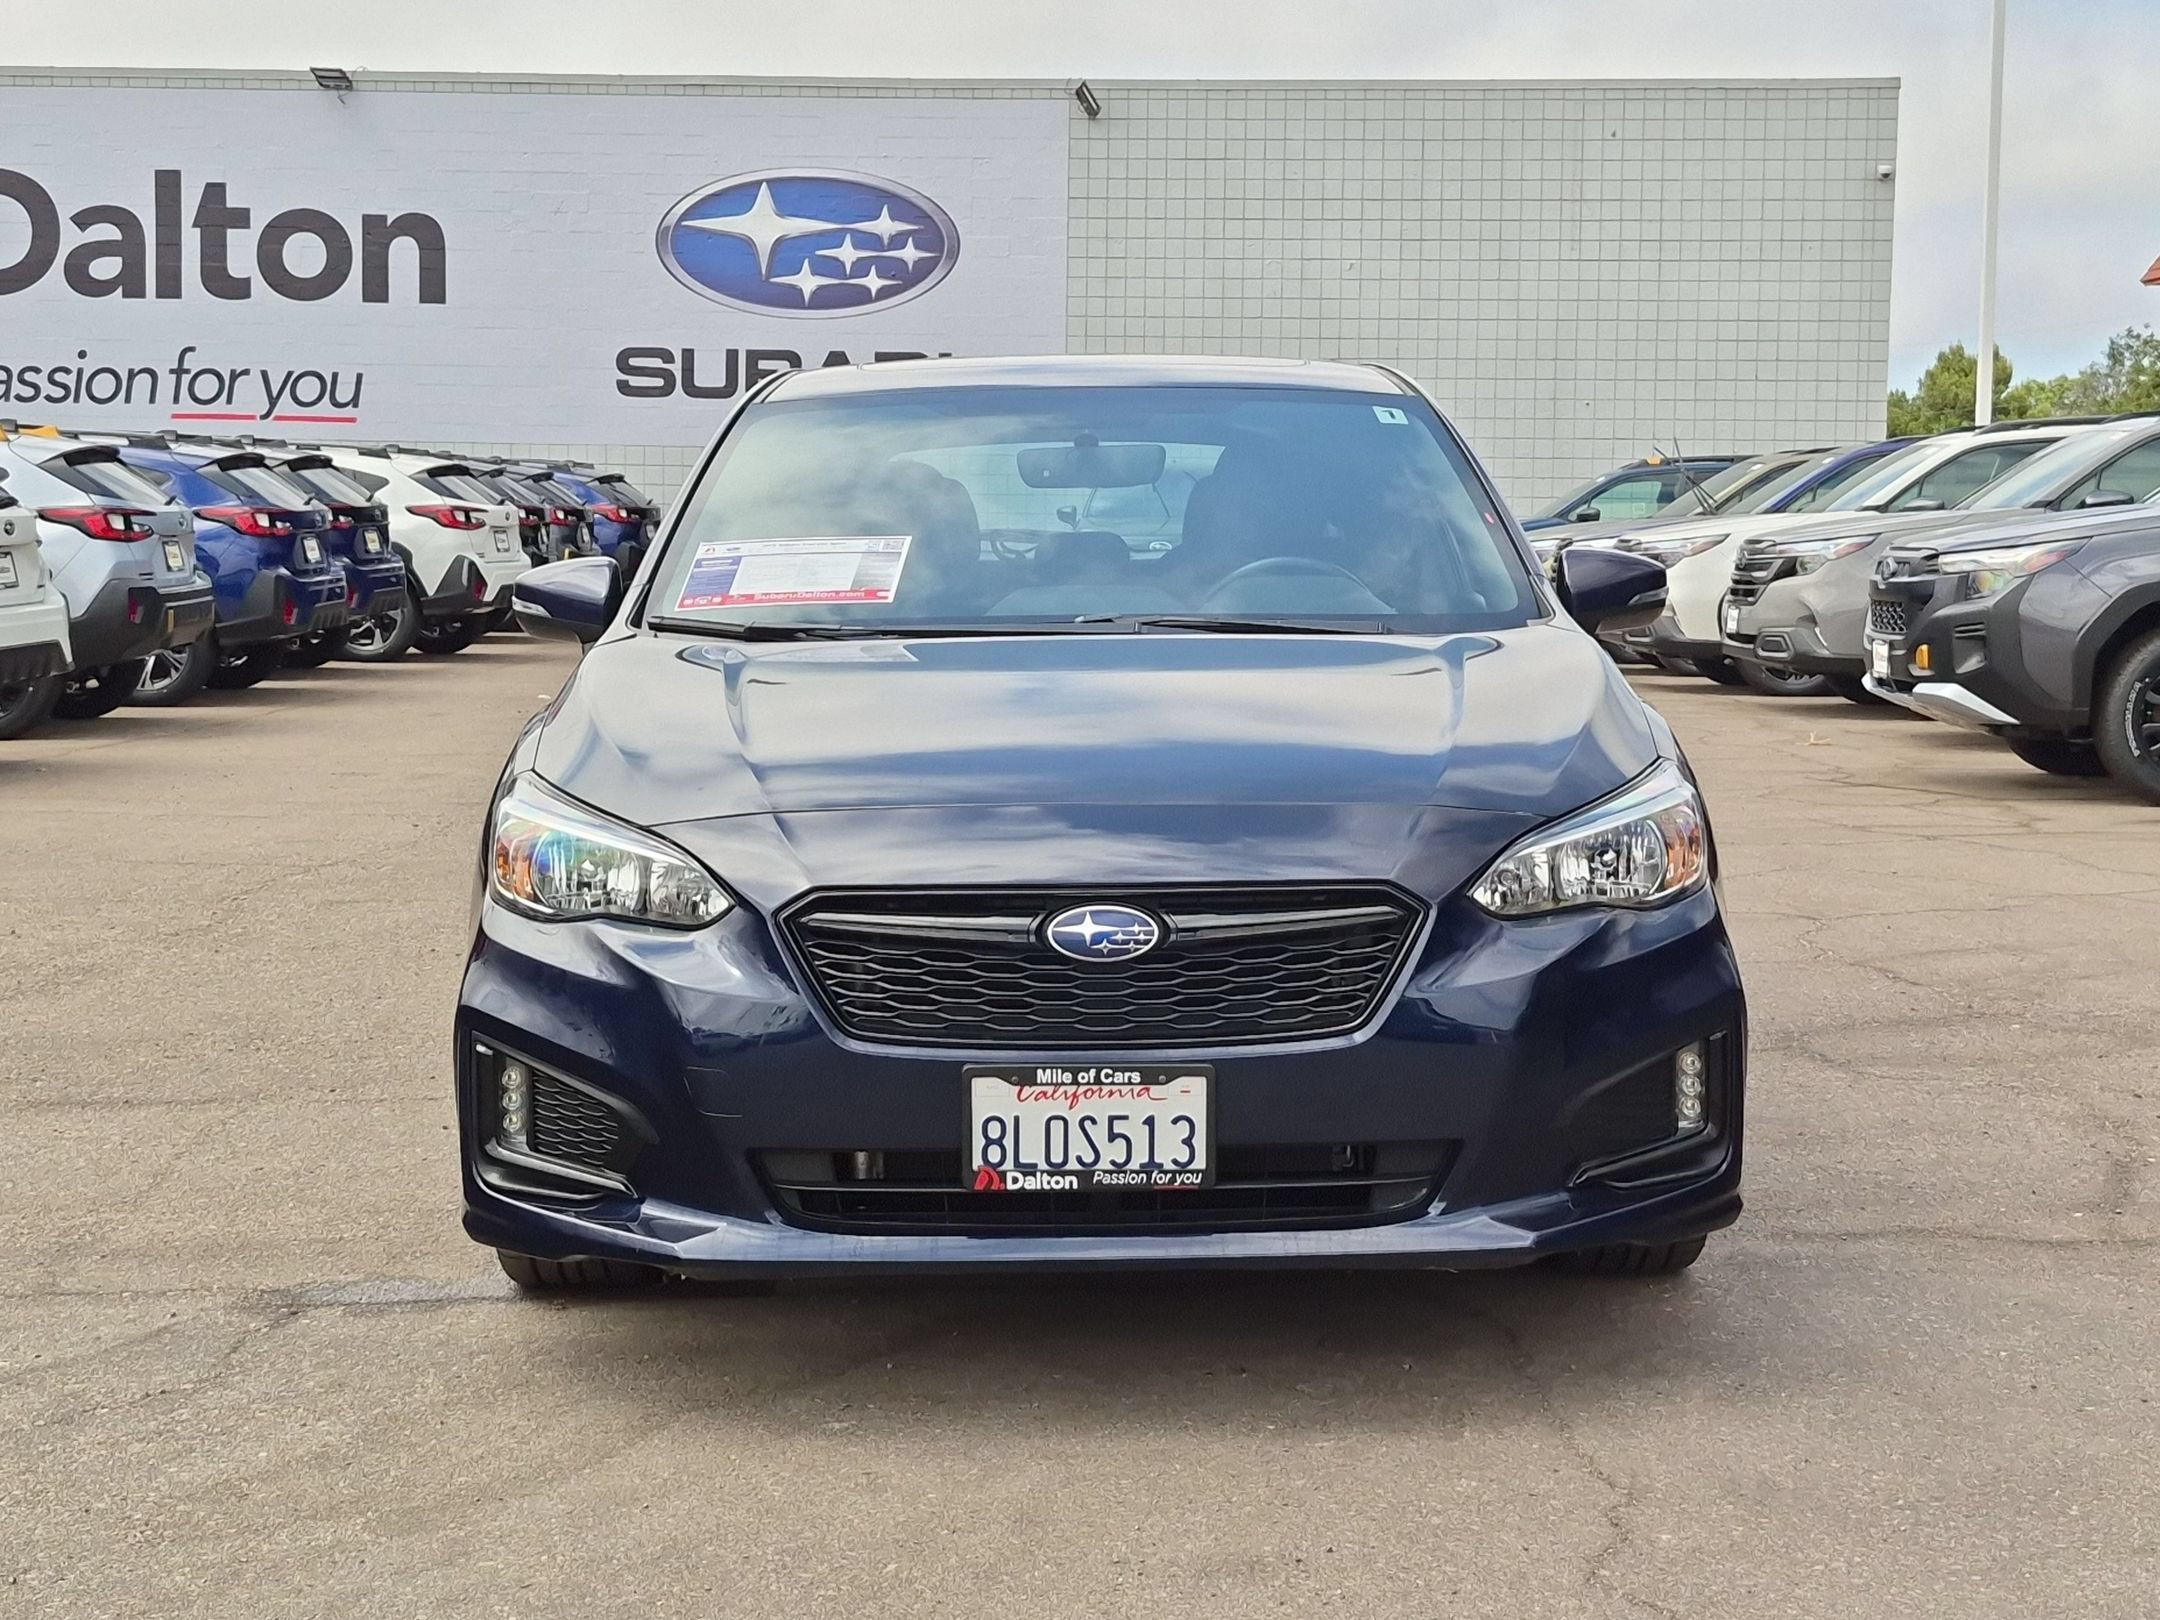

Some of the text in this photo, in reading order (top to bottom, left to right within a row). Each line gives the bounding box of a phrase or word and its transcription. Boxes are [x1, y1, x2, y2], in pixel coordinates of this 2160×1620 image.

[0, 168, 447, 304] Dalton
[168, 345, 250, 406] for
[259, 368, 363, 421] you
[1036, 1068, 1141, 1084] Mile of Cars
[1016, 1084, 1168, 1110] California
[981, 1114, 1196, 1170] 8LOS513
[1006, 1171, 1078, 1191] Dalton
[1093, 1170, 1202, 1188] Passion for you
